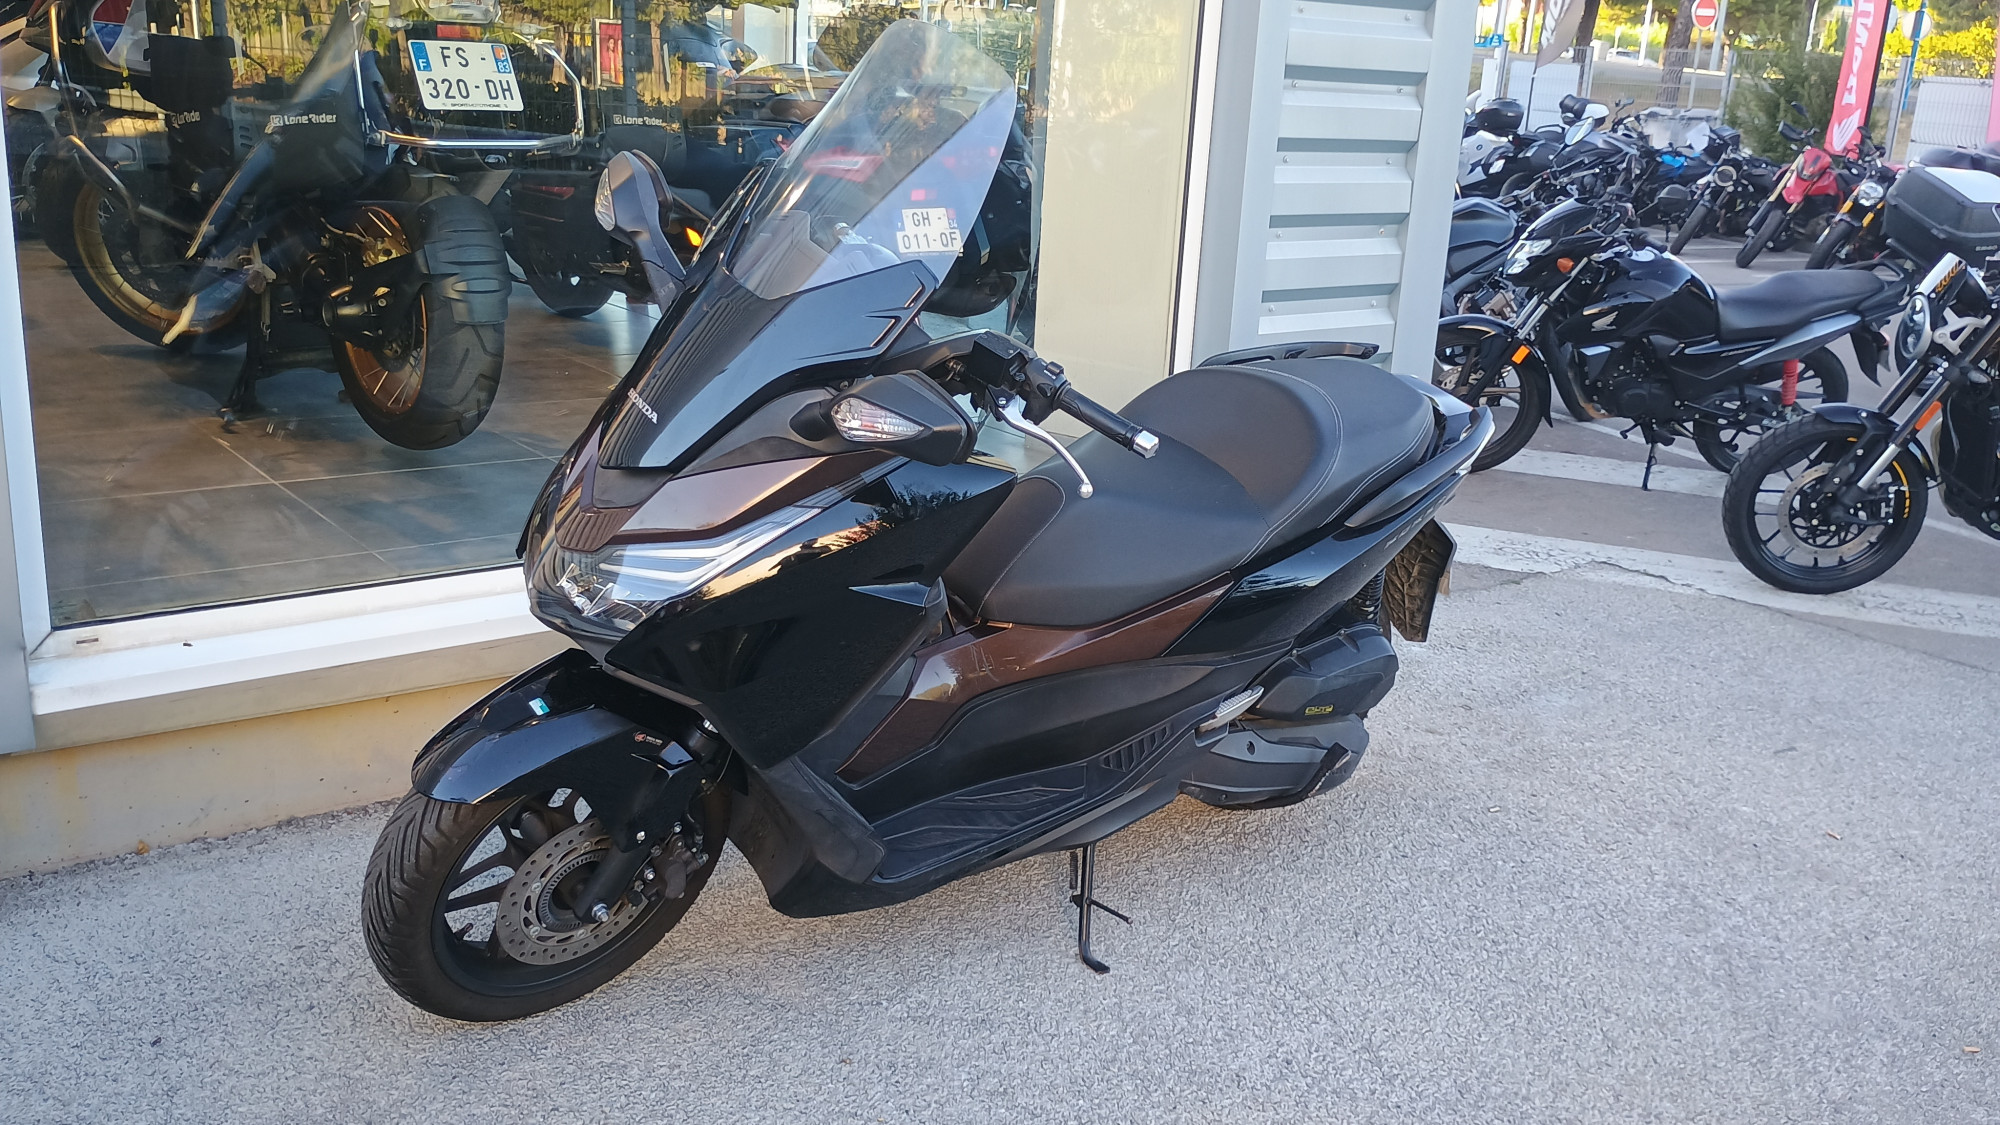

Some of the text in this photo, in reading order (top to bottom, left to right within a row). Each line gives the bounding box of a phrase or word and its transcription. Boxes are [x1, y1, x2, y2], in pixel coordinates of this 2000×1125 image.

[419, 59, 428, 70] F
[498, 61, 511, 73] 83
[425, 78, 514, 100] 320-DH
[283, 115, 309, 125] Lone
[309, 113, 337, 124] Rider
[623, 115, 643, 125] Lone
[948, 220, 958, 228] 34
[902, 231, 958, 250] 011-QF
[627, 387, 658, 424] HONDA
